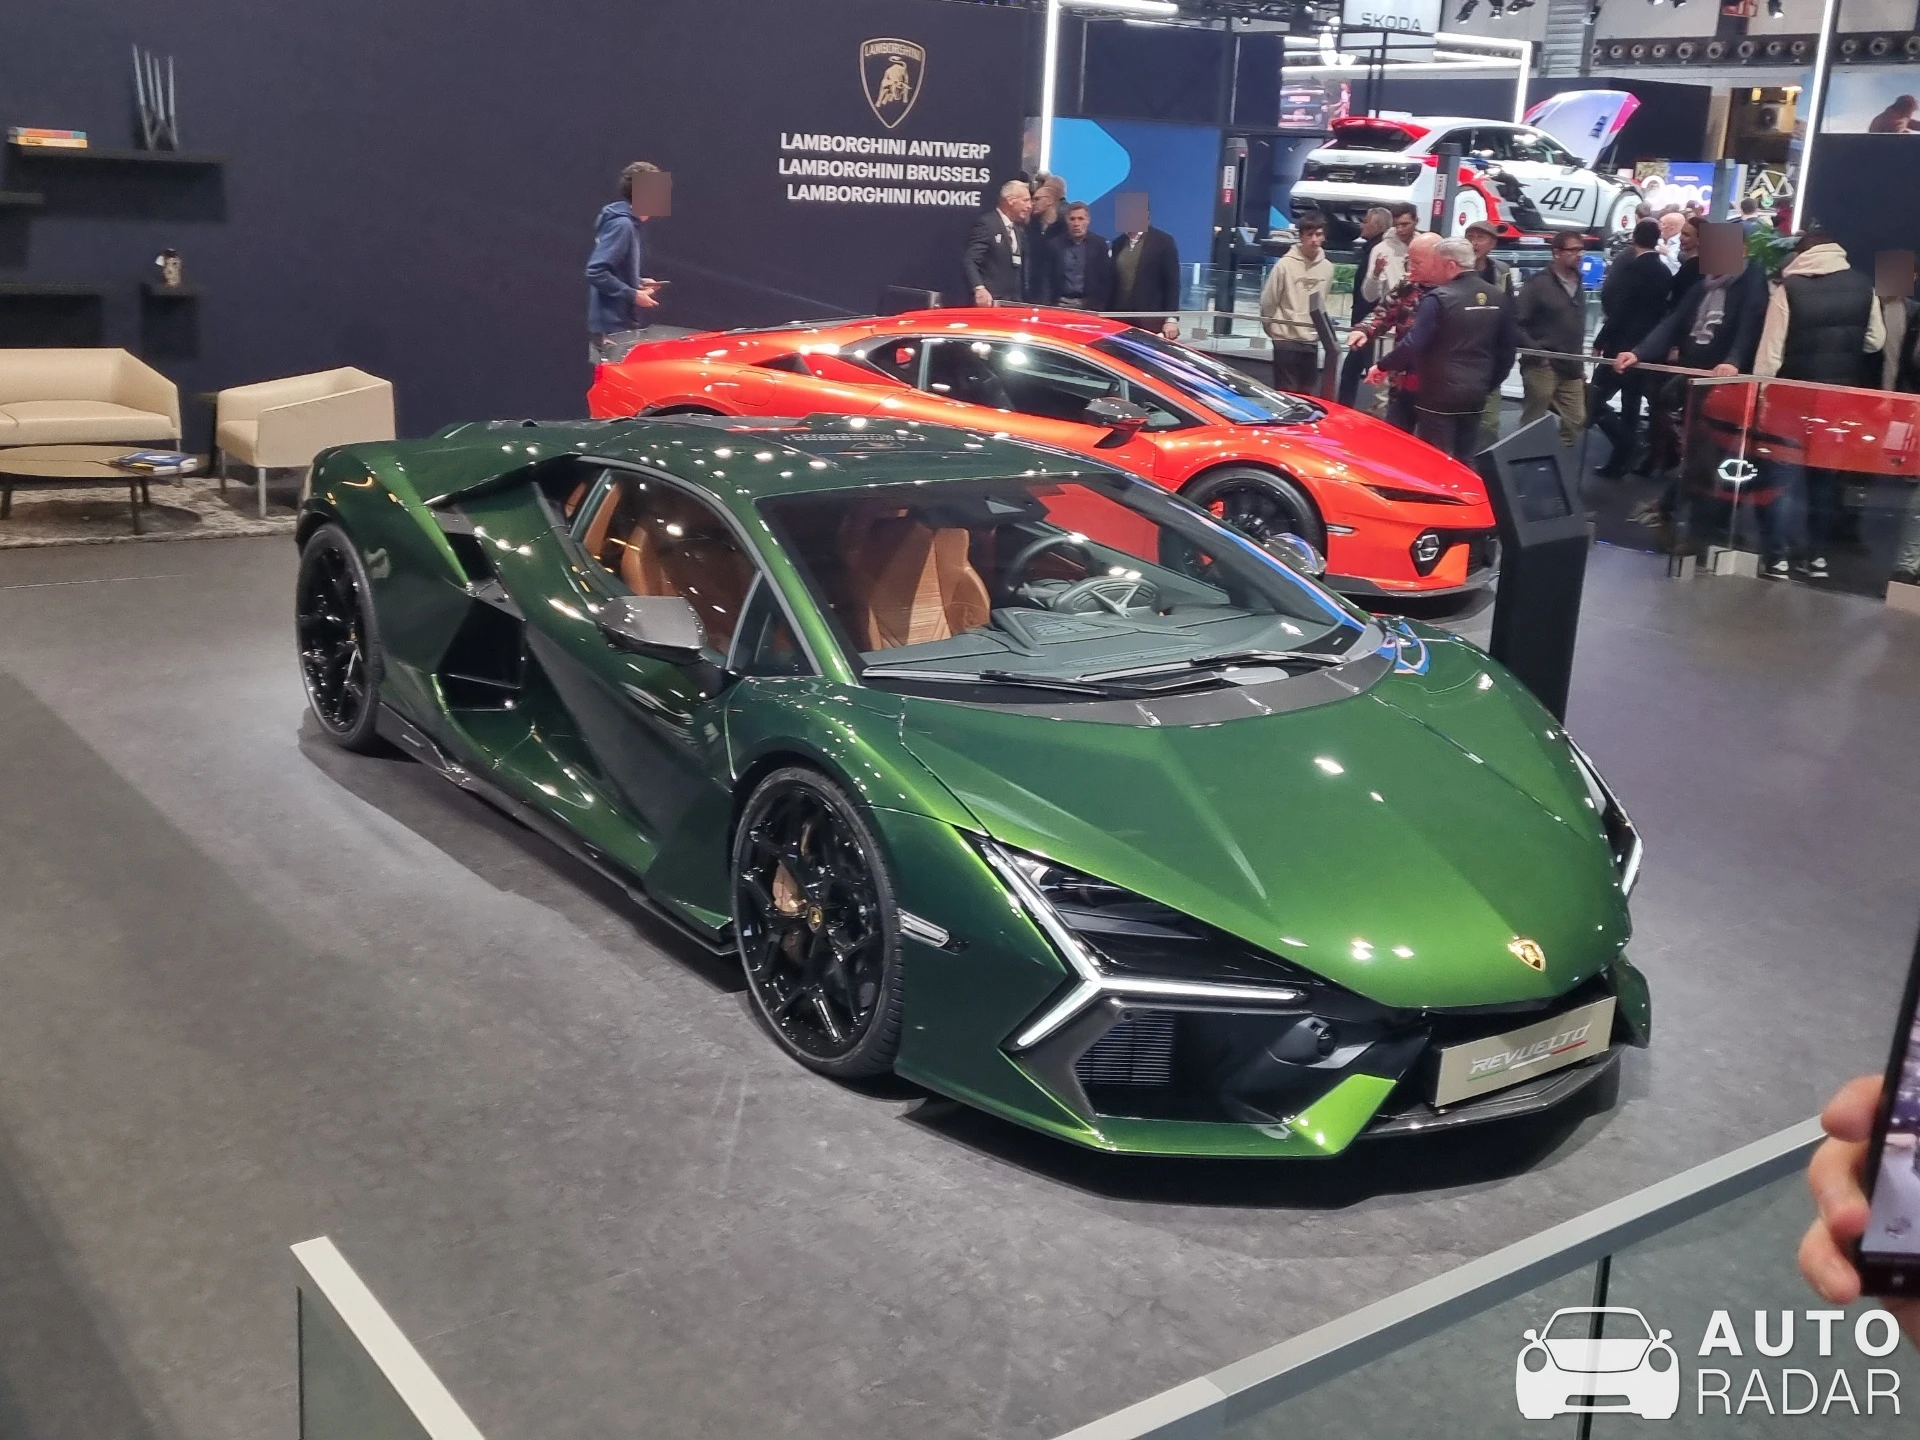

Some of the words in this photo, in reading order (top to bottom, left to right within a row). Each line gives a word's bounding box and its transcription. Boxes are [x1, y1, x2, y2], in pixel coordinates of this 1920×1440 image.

[780, 132, 906, 156] LAMBORGHINI
[908, 140, 991, 160] ANTWERP
[778, 157, 904, 180] LAMBORGHINI
[906, 164, 991, 184] BRUSSELS
[787, 183, 911, 205] LAMBORGHINI
[913, 188, 981, 207] KNOKKE
[1540, 186, 1586, 211] 40
[1469, 1022, 1592, 1076] REVUELTO
